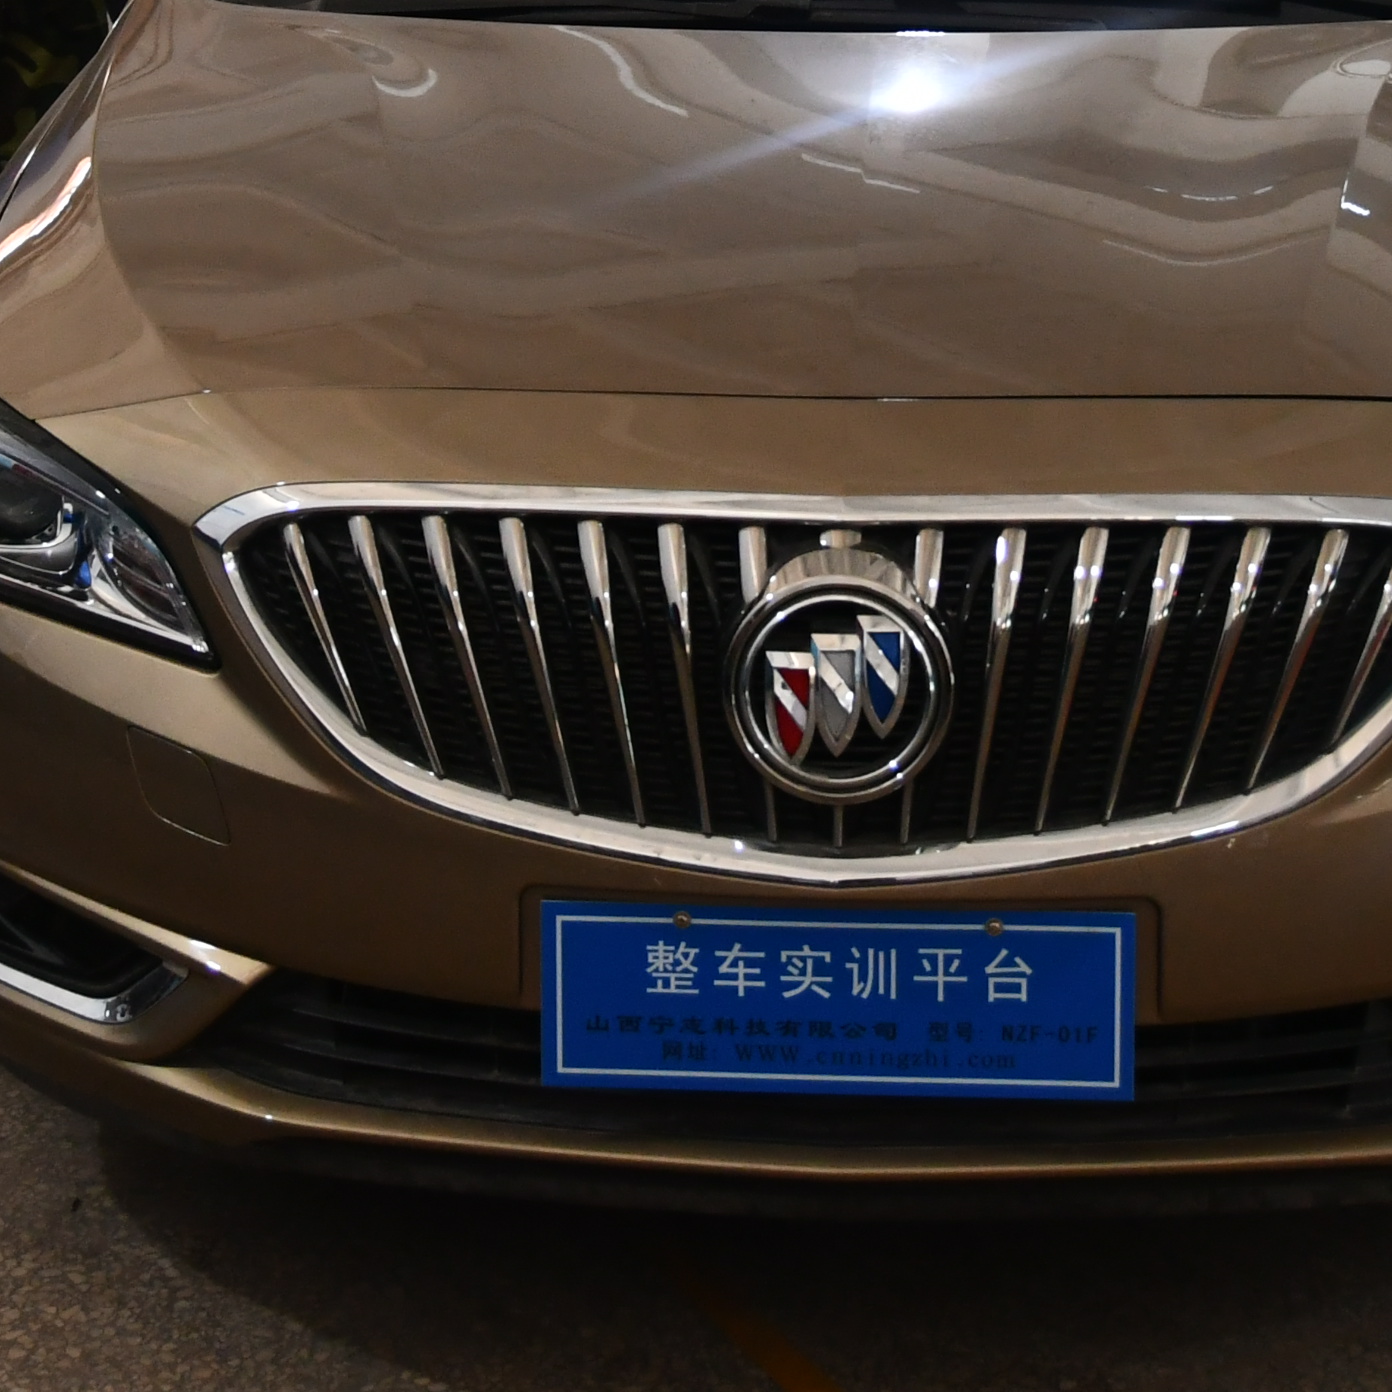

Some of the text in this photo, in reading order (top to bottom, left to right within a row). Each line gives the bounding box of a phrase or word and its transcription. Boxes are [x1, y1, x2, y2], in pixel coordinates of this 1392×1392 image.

[645, 939, 1035, 1004] 整车实训平台
